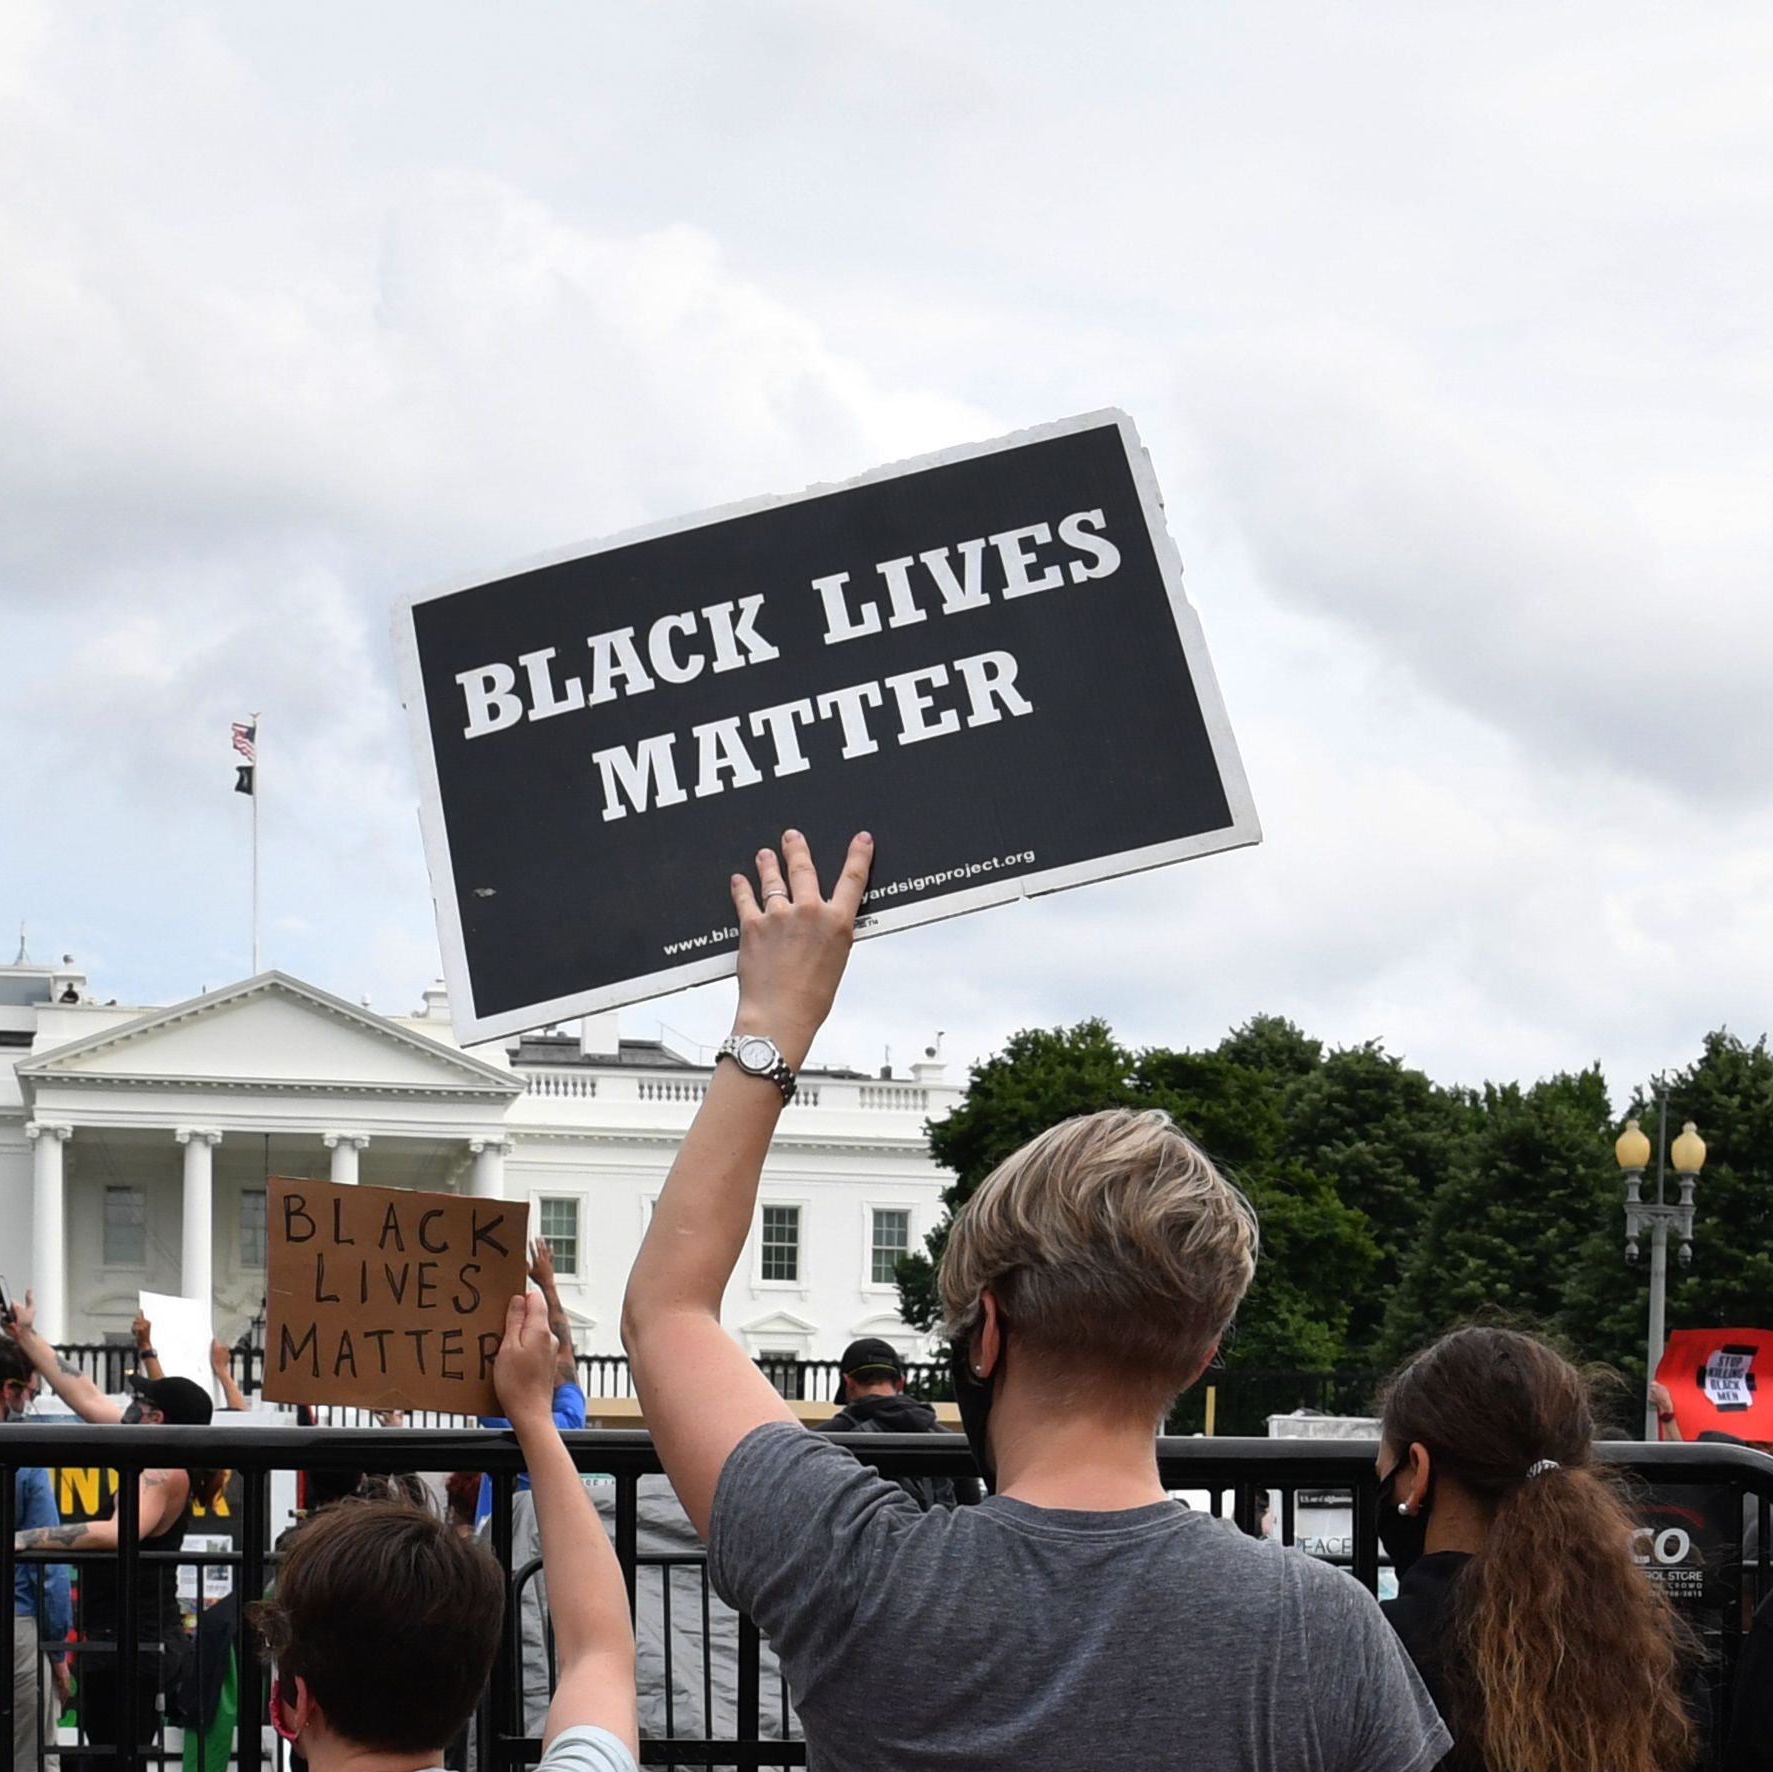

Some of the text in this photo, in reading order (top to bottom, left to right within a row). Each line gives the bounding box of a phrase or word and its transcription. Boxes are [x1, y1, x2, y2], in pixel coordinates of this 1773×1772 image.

[455, 508, 1122, 740] BLACK LIVES
[591, 650, 1033, 822] MATTER
[663, 849, 1036, 956] www.blayardsignproject.org
[283, 1194, 509, 1258] BLACK
[315, 1253, 481, 1315] LIVES
[279, 1322, 501, 1381] MATTER
[1707, 1367, 1745, 1380] KILLING
[1718, 1356, 1743, 1368] STOP
[1710, 1379, 1741, 1391] BLACK
[1717, 1391, 1739, 1402] MEN
[1668, 1571, 1703, 1581] STORE
